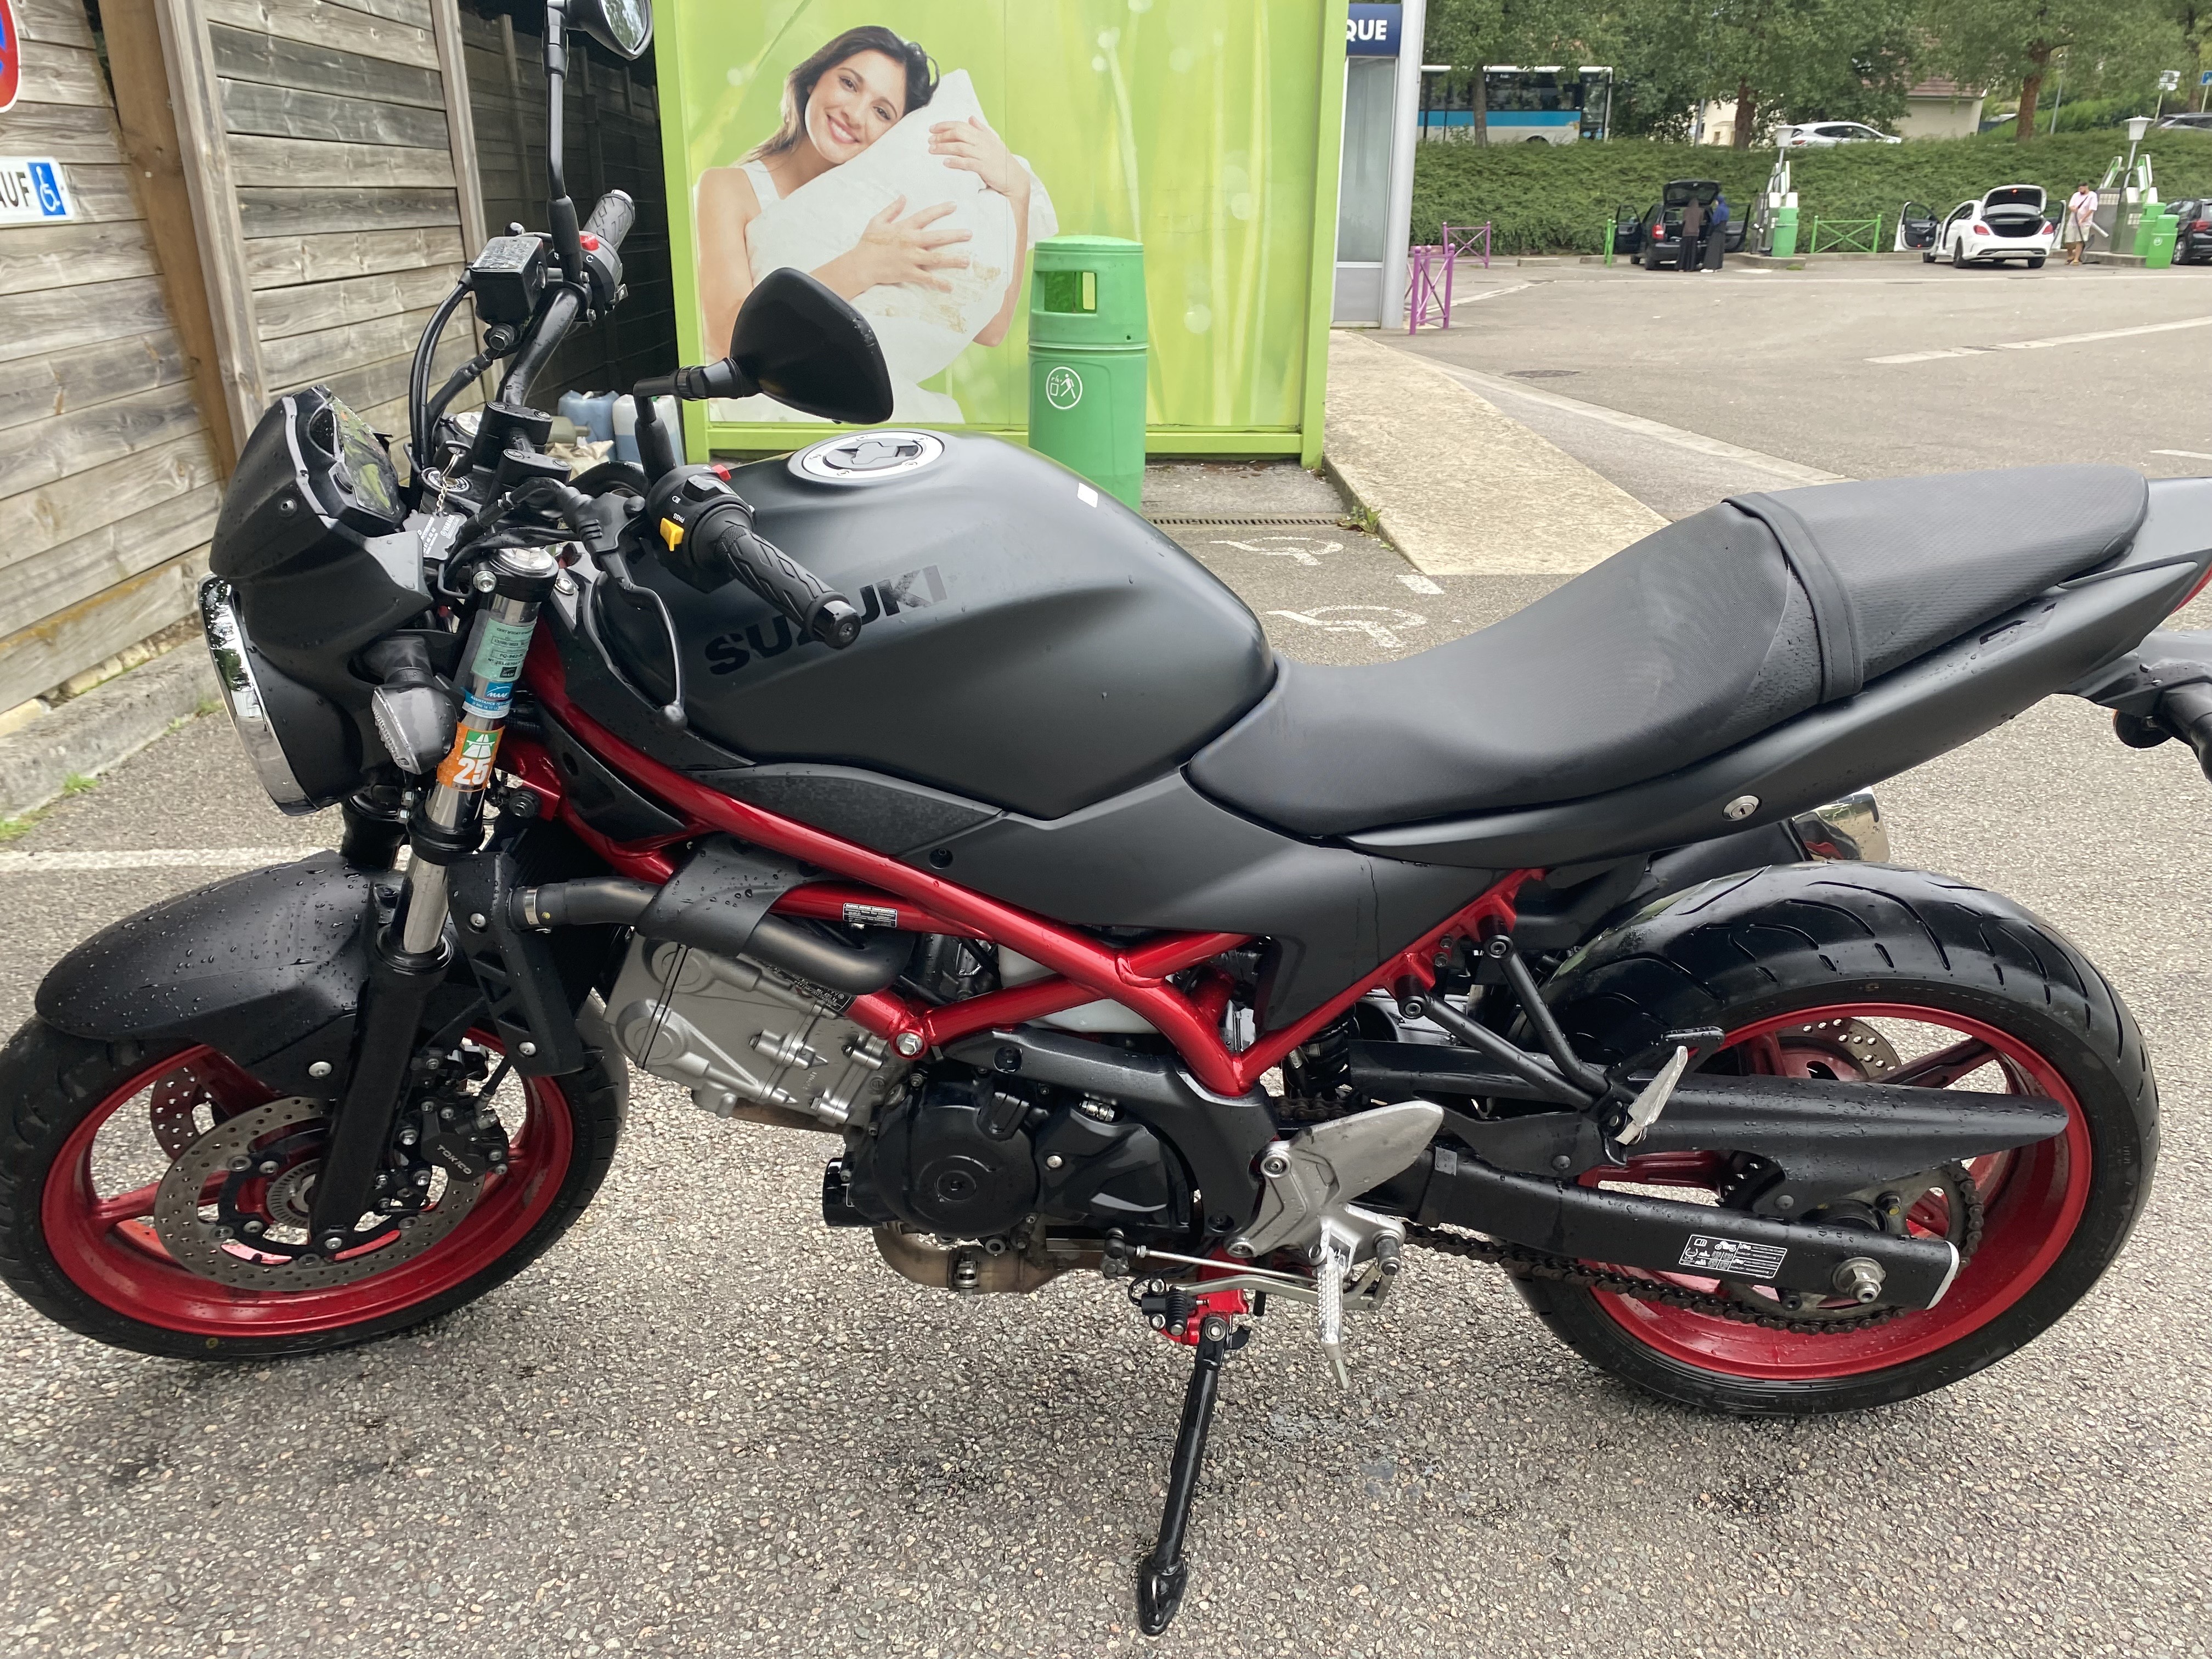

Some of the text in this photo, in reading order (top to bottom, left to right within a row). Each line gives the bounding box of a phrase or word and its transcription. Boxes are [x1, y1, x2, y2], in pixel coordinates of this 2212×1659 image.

[442, 514, 455, 532] YAMAHA
[673, 513, 685, 523] PASS
[705, 565, 947, 675] SUKI
[471, 696, 497, 706] ASSISTANCE
[453, 757, 492, 785] 25
[436, 1144, 472, 1175] TOKICO
